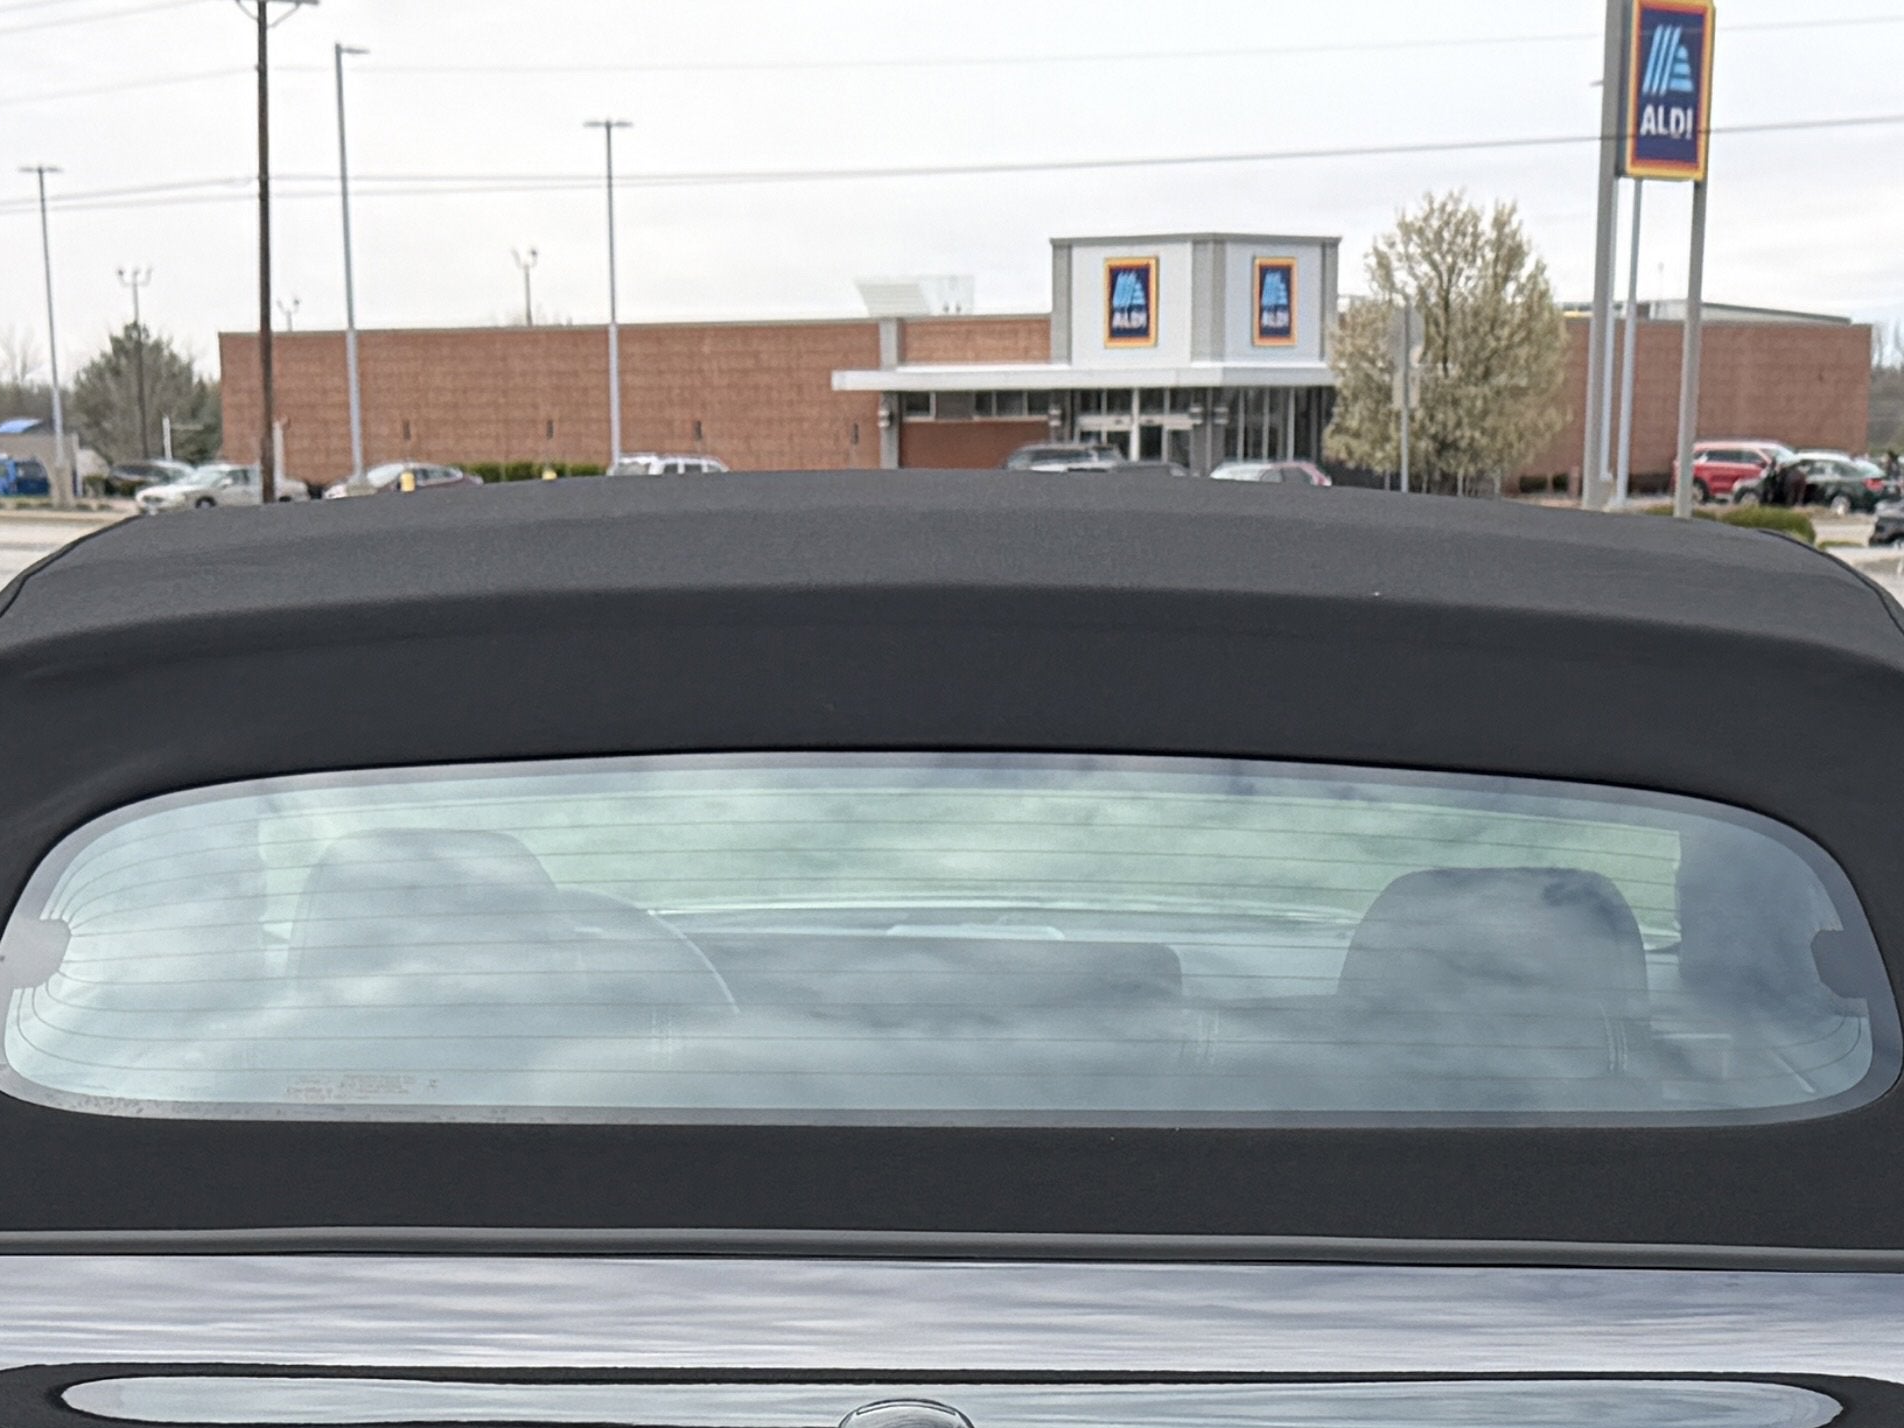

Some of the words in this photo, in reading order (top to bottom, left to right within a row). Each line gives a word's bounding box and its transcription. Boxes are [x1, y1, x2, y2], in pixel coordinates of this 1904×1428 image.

[1640, 105, 1694, 141] ALDI
[1112, 311, 1146, 329] ALDI
[1261, 311, 1289, 329] ALDI
